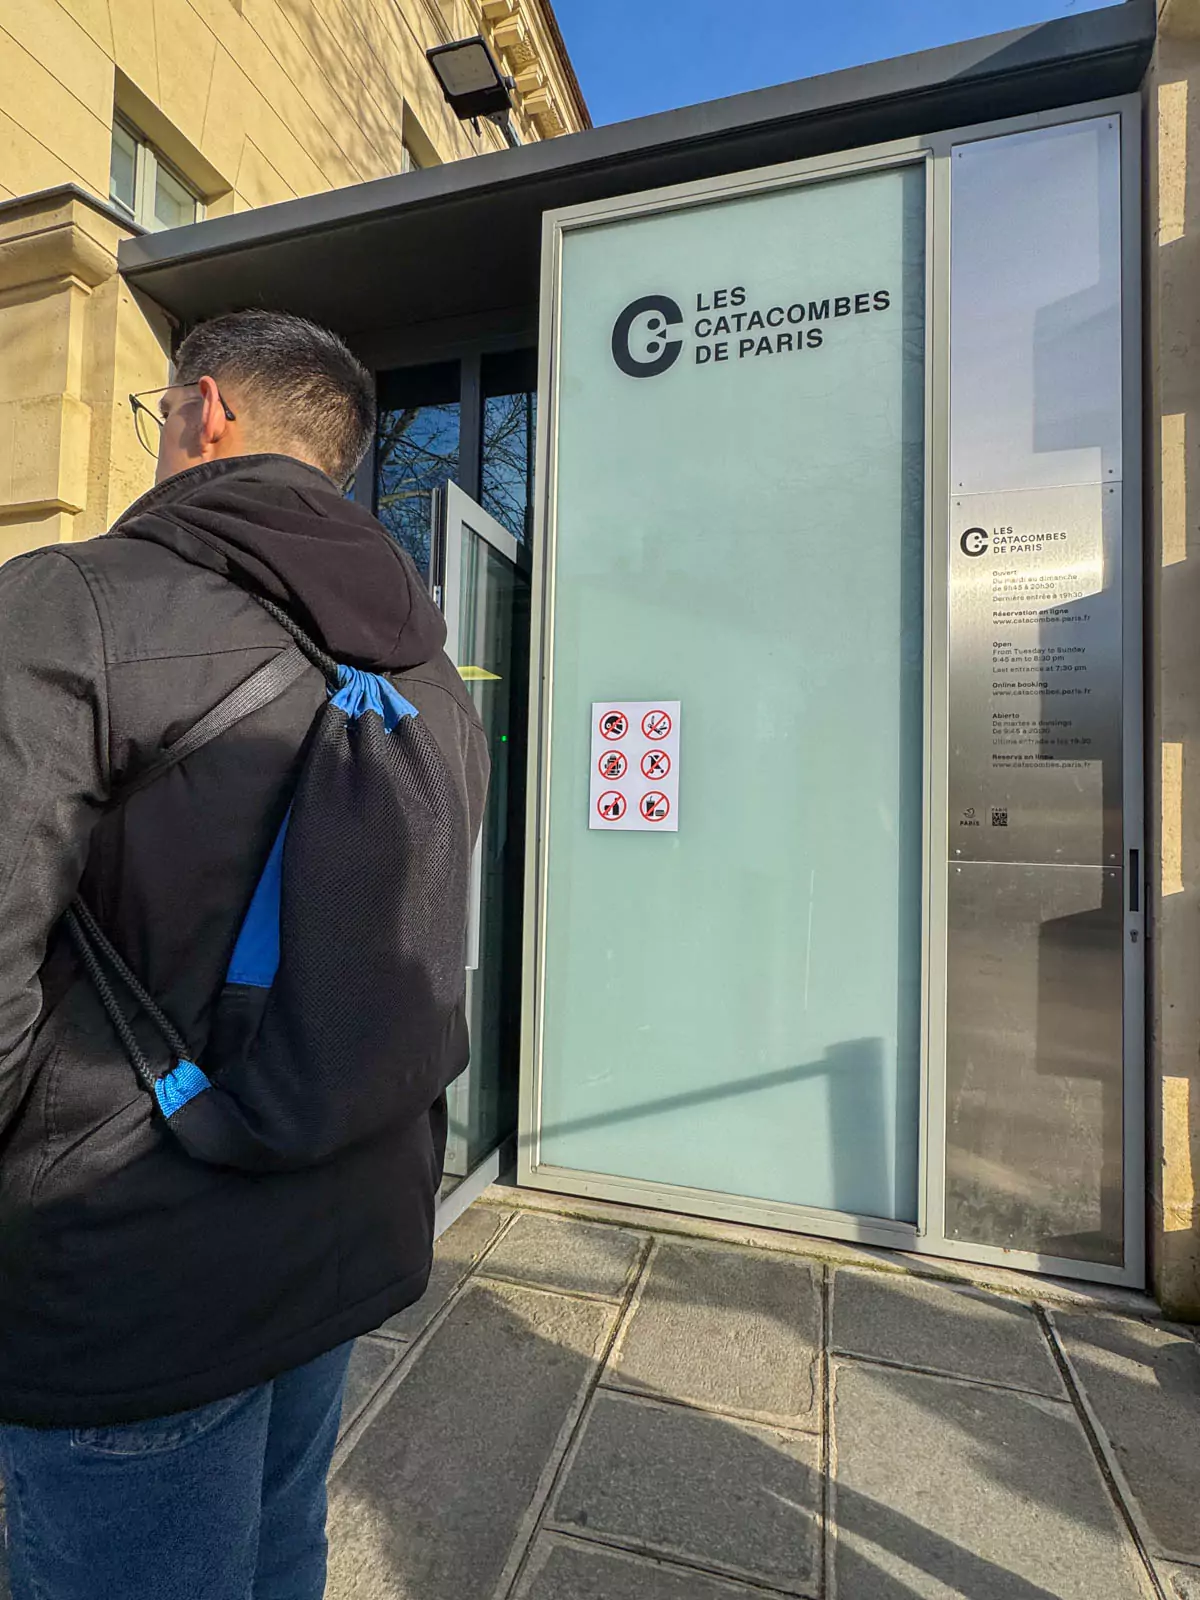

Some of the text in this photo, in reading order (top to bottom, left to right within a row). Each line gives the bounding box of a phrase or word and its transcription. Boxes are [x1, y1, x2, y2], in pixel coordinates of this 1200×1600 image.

[696, 286, 746, 312] LES
[694, 290, 891, 338] CATACOMBES
[695, 328, 823, 365] DE PARIS
[993, 526, 1013, 535] LES
[993, 532, 1067, 545] CATACOMBES
[1010, 544, 1042, 552] PARIS
